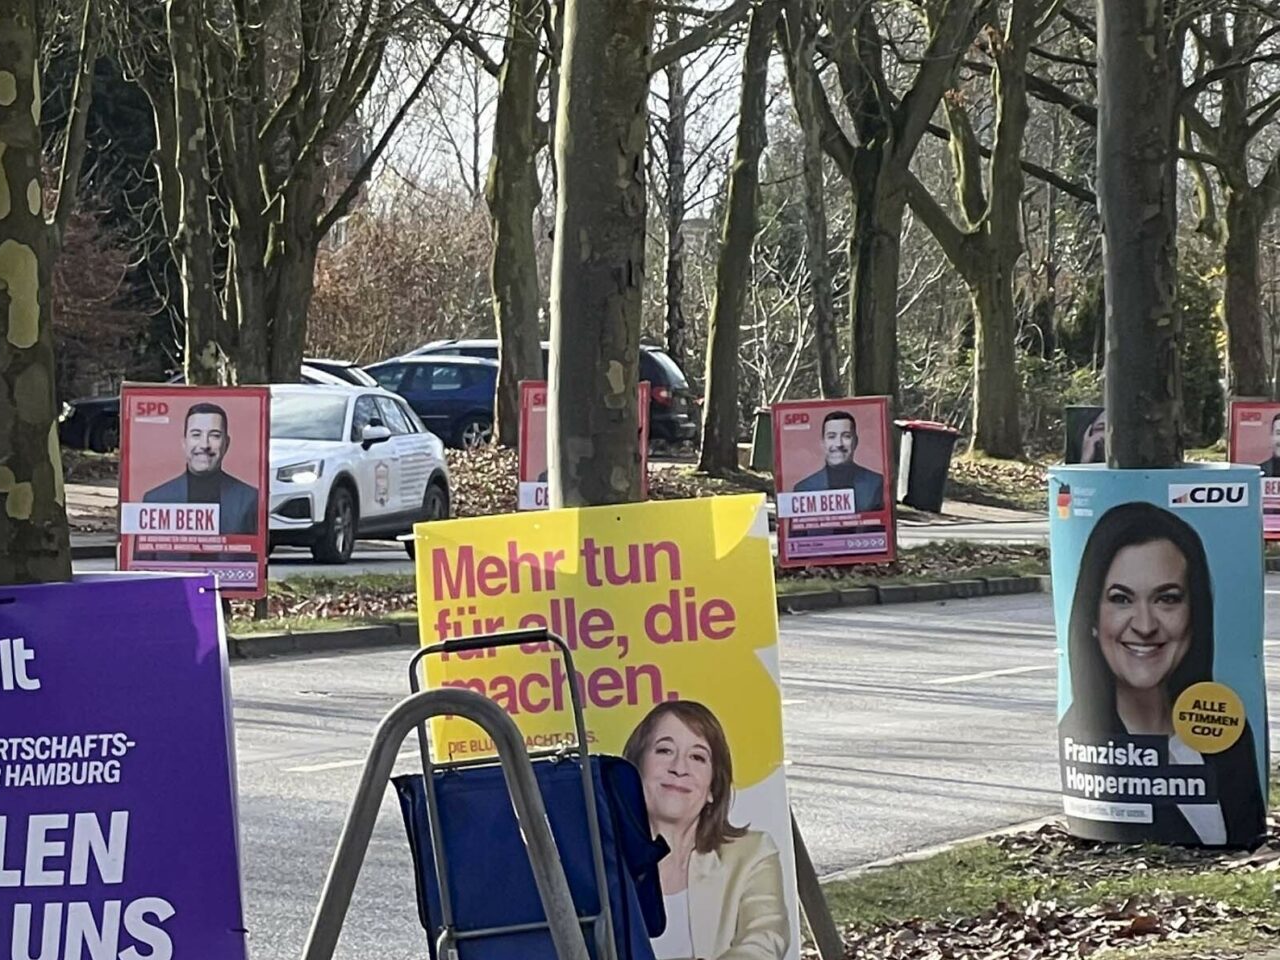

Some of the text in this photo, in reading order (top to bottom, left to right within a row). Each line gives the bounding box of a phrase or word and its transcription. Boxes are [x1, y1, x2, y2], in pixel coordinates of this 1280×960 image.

[137, 402, 170, 416] SPD
[784, 413, 810, 425] SPD
[791, 493, 851, 514] CEM BERK
[1190, 487, 1244, 503] CDU
[139, 508, 214, 531] CEM BERK
[432, 537, 681, 602] Mehr tun
[434, 586, 737, 662] für alle, die
[1192, 699, 1227, 713] ALLE
[1179, 711, 1239, 726] STIMMEN
[448, 730, 600, 754] DIE BLU ACHT DS.
[1191, 725, 1223, 737] CDU
[1064, 737, 1159, 766] Franziska
[5, 759, 121, 787] HAMBURG
[1066, 767, 1206, 798] Hoppermann
